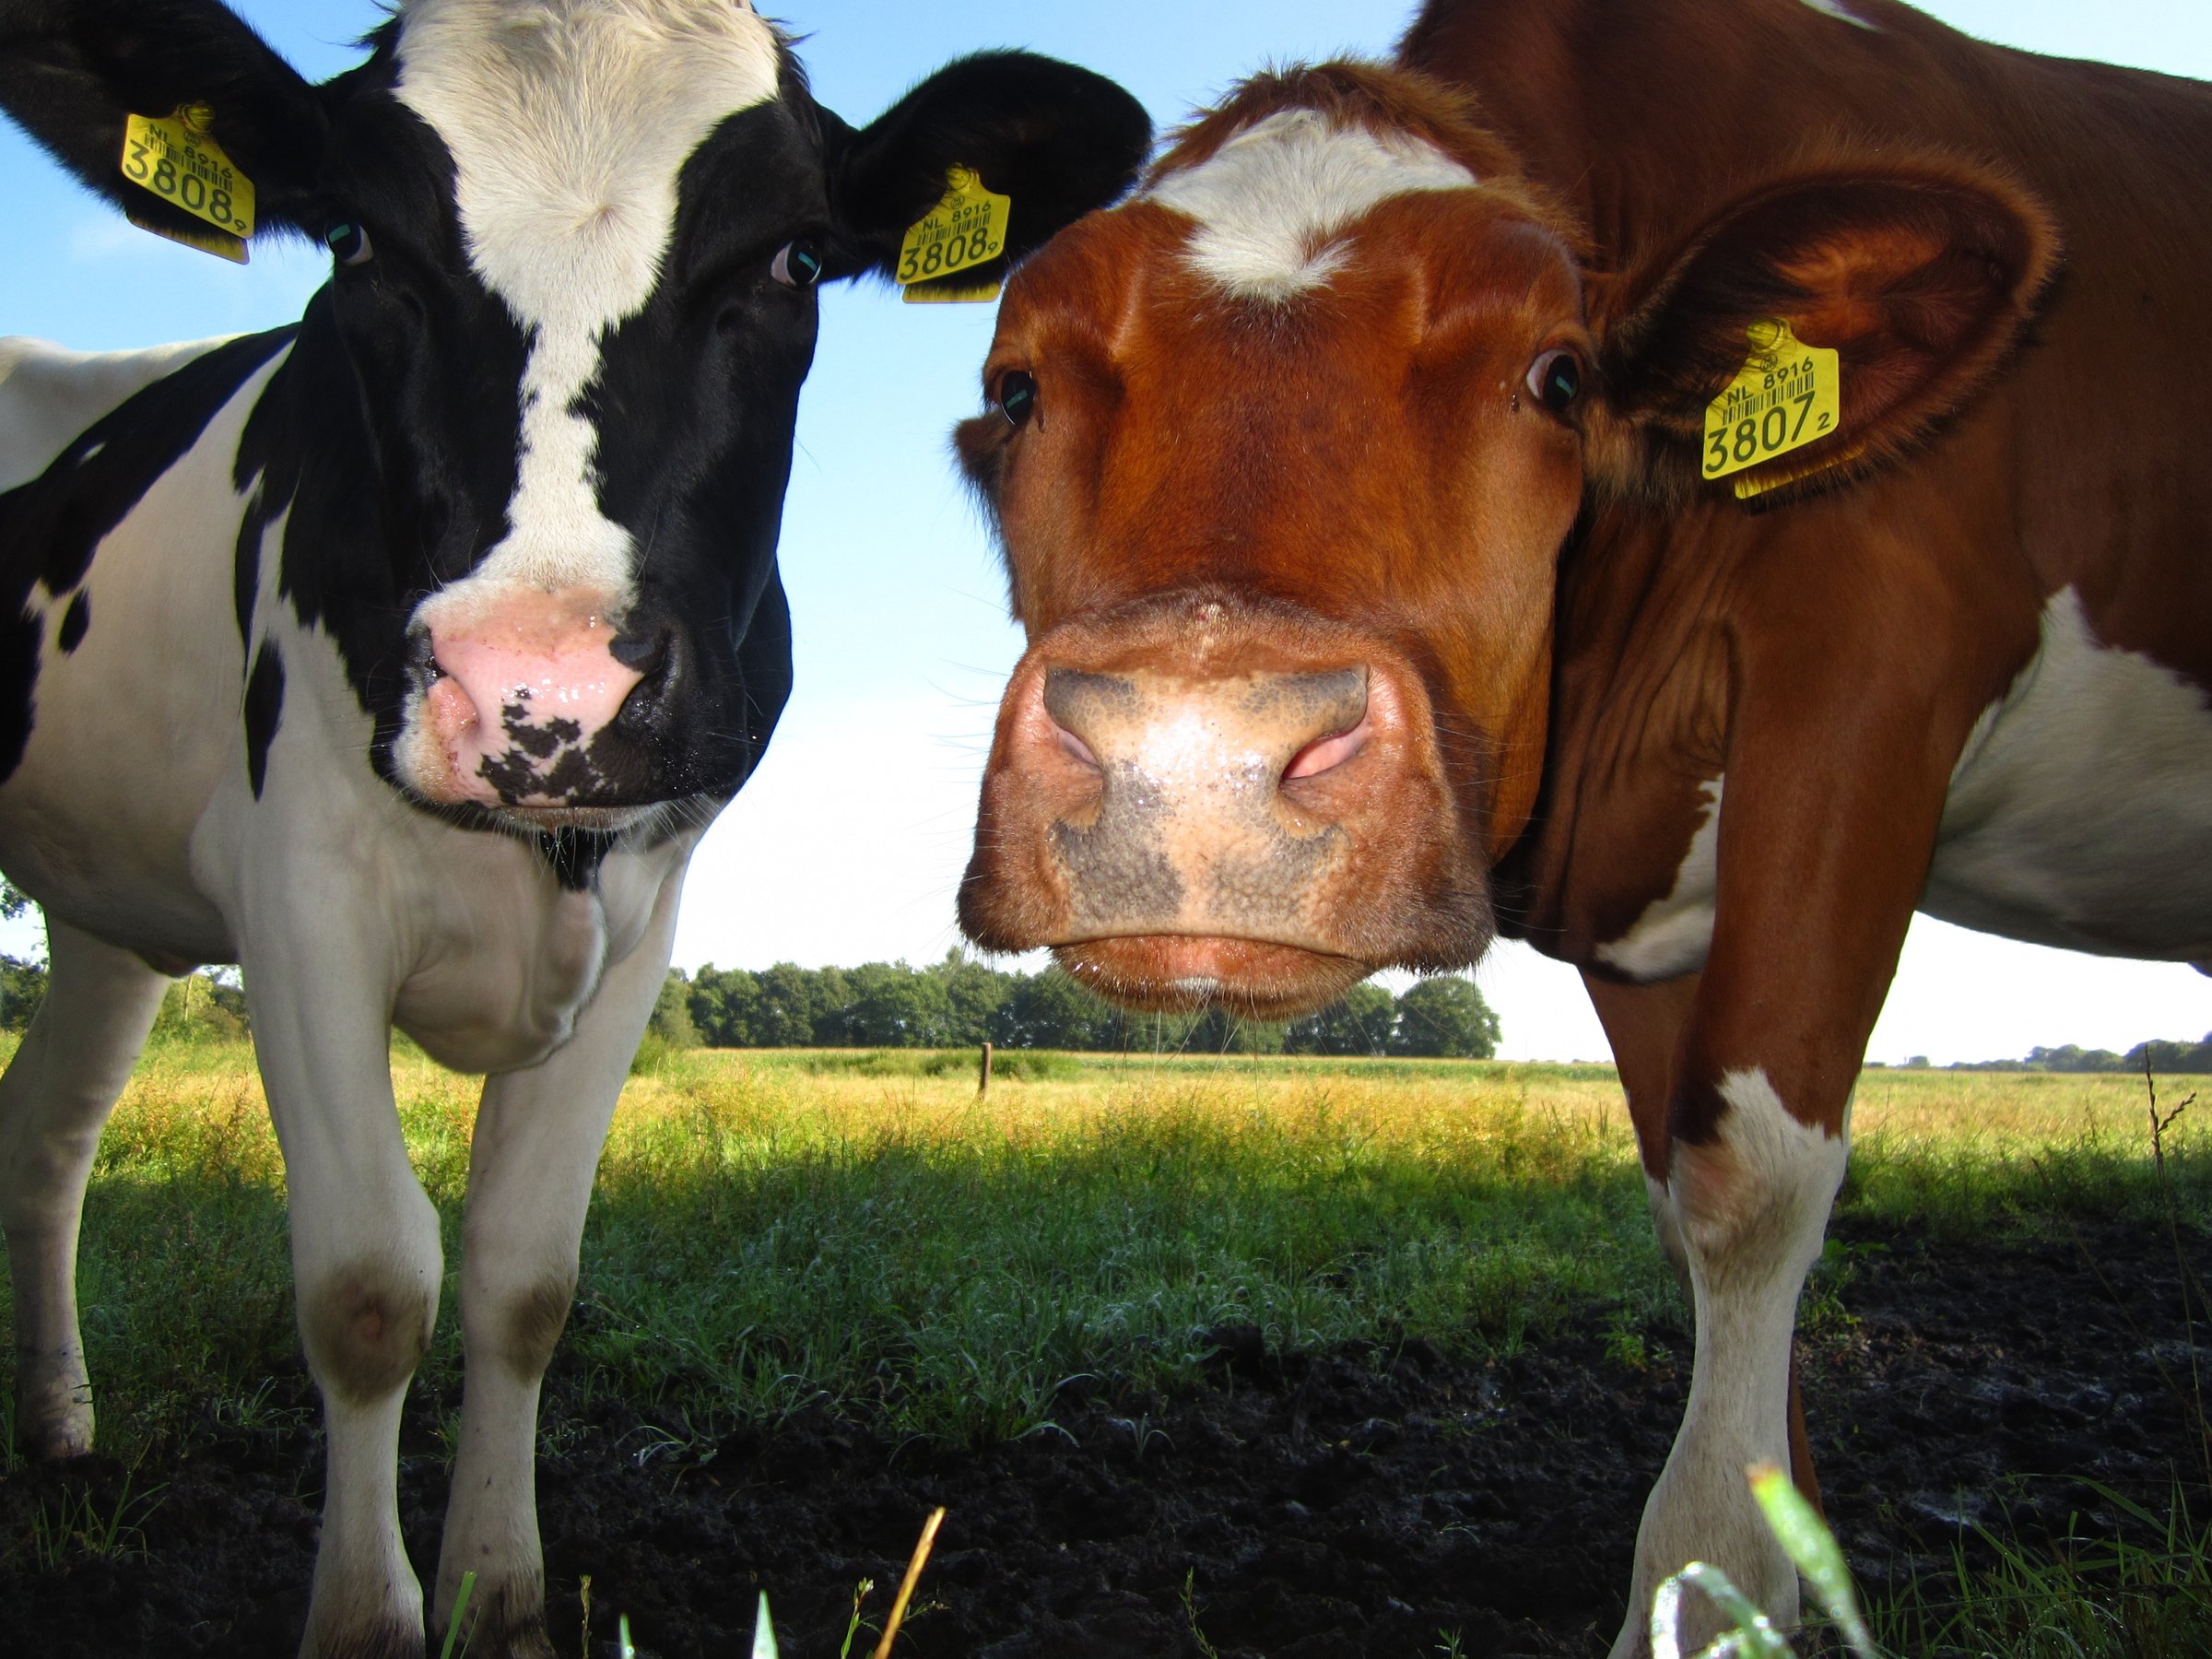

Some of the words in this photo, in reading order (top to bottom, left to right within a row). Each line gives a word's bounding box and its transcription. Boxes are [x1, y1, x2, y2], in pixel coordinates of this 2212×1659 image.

[149, 124, 173, 147] NL
[185, 147, 232, 179] 8916
[125, 139, 232, 224] 3808
[923, 218, 943, 231] NL
[952, 200, 992, 223] 8916
[900, 227, 988, 279] 3808
[1727, 385, 1754, 406] NL
[1763, 356, 1814, 390] 8916
[1705, 390, 1815, 473] 3807
[1818, 412, 1830, 431] 2
